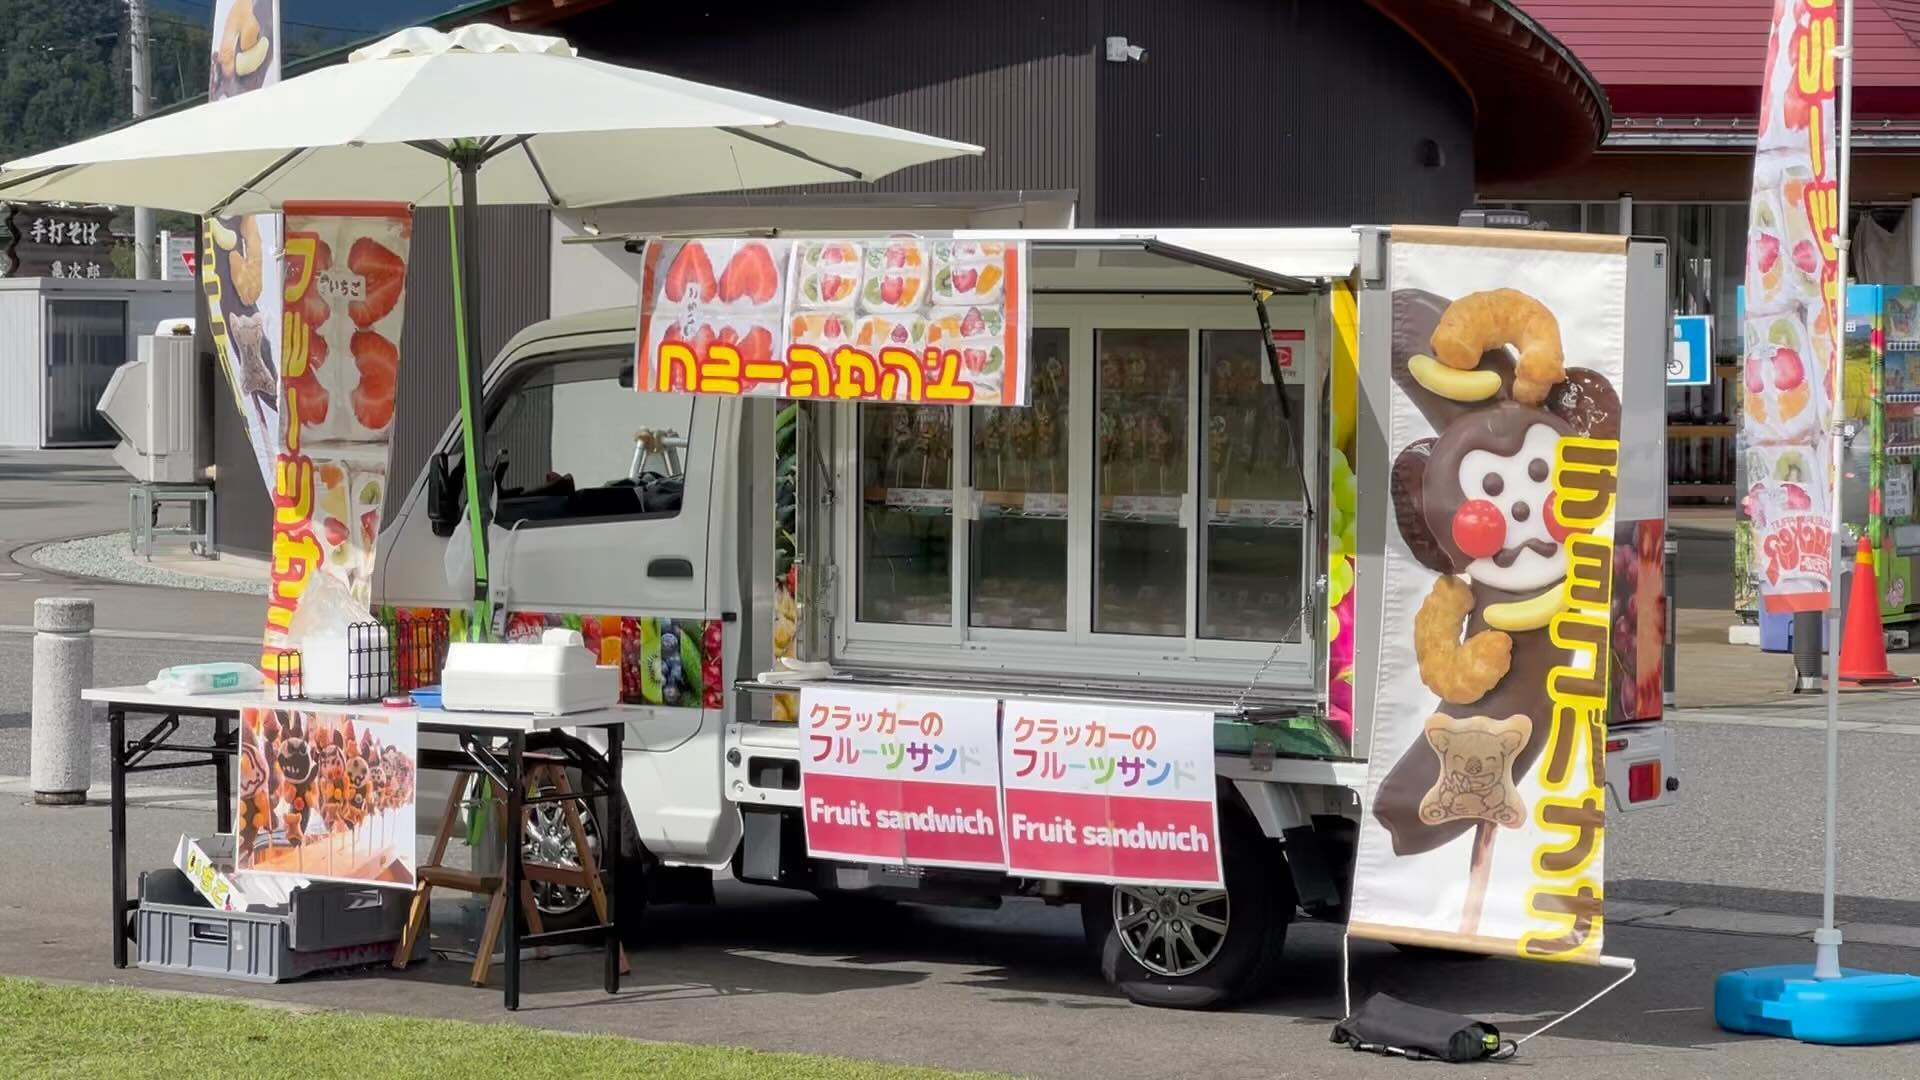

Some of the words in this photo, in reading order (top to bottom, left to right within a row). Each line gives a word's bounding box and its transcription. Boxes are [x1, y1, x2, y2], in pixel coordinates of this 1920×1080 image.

[30, 217, 100, 246] 手打そば
[658, 341, 974, 402] フルーツサンド
[809, 703, 944, 737] クラッカーの
[1013, 717, 1157, 751] クラッカーの
[809, 734, 981, 774] フルーツサンド
[1012, 748, 1197, 789] フルーツサンド
[810, 798, 870, 828] Fruit
[875, 802, 994, 836] sandwich
[1013, 814, 1077, 845] Fruit
[1083, 820, 1210, 853] sandwich
